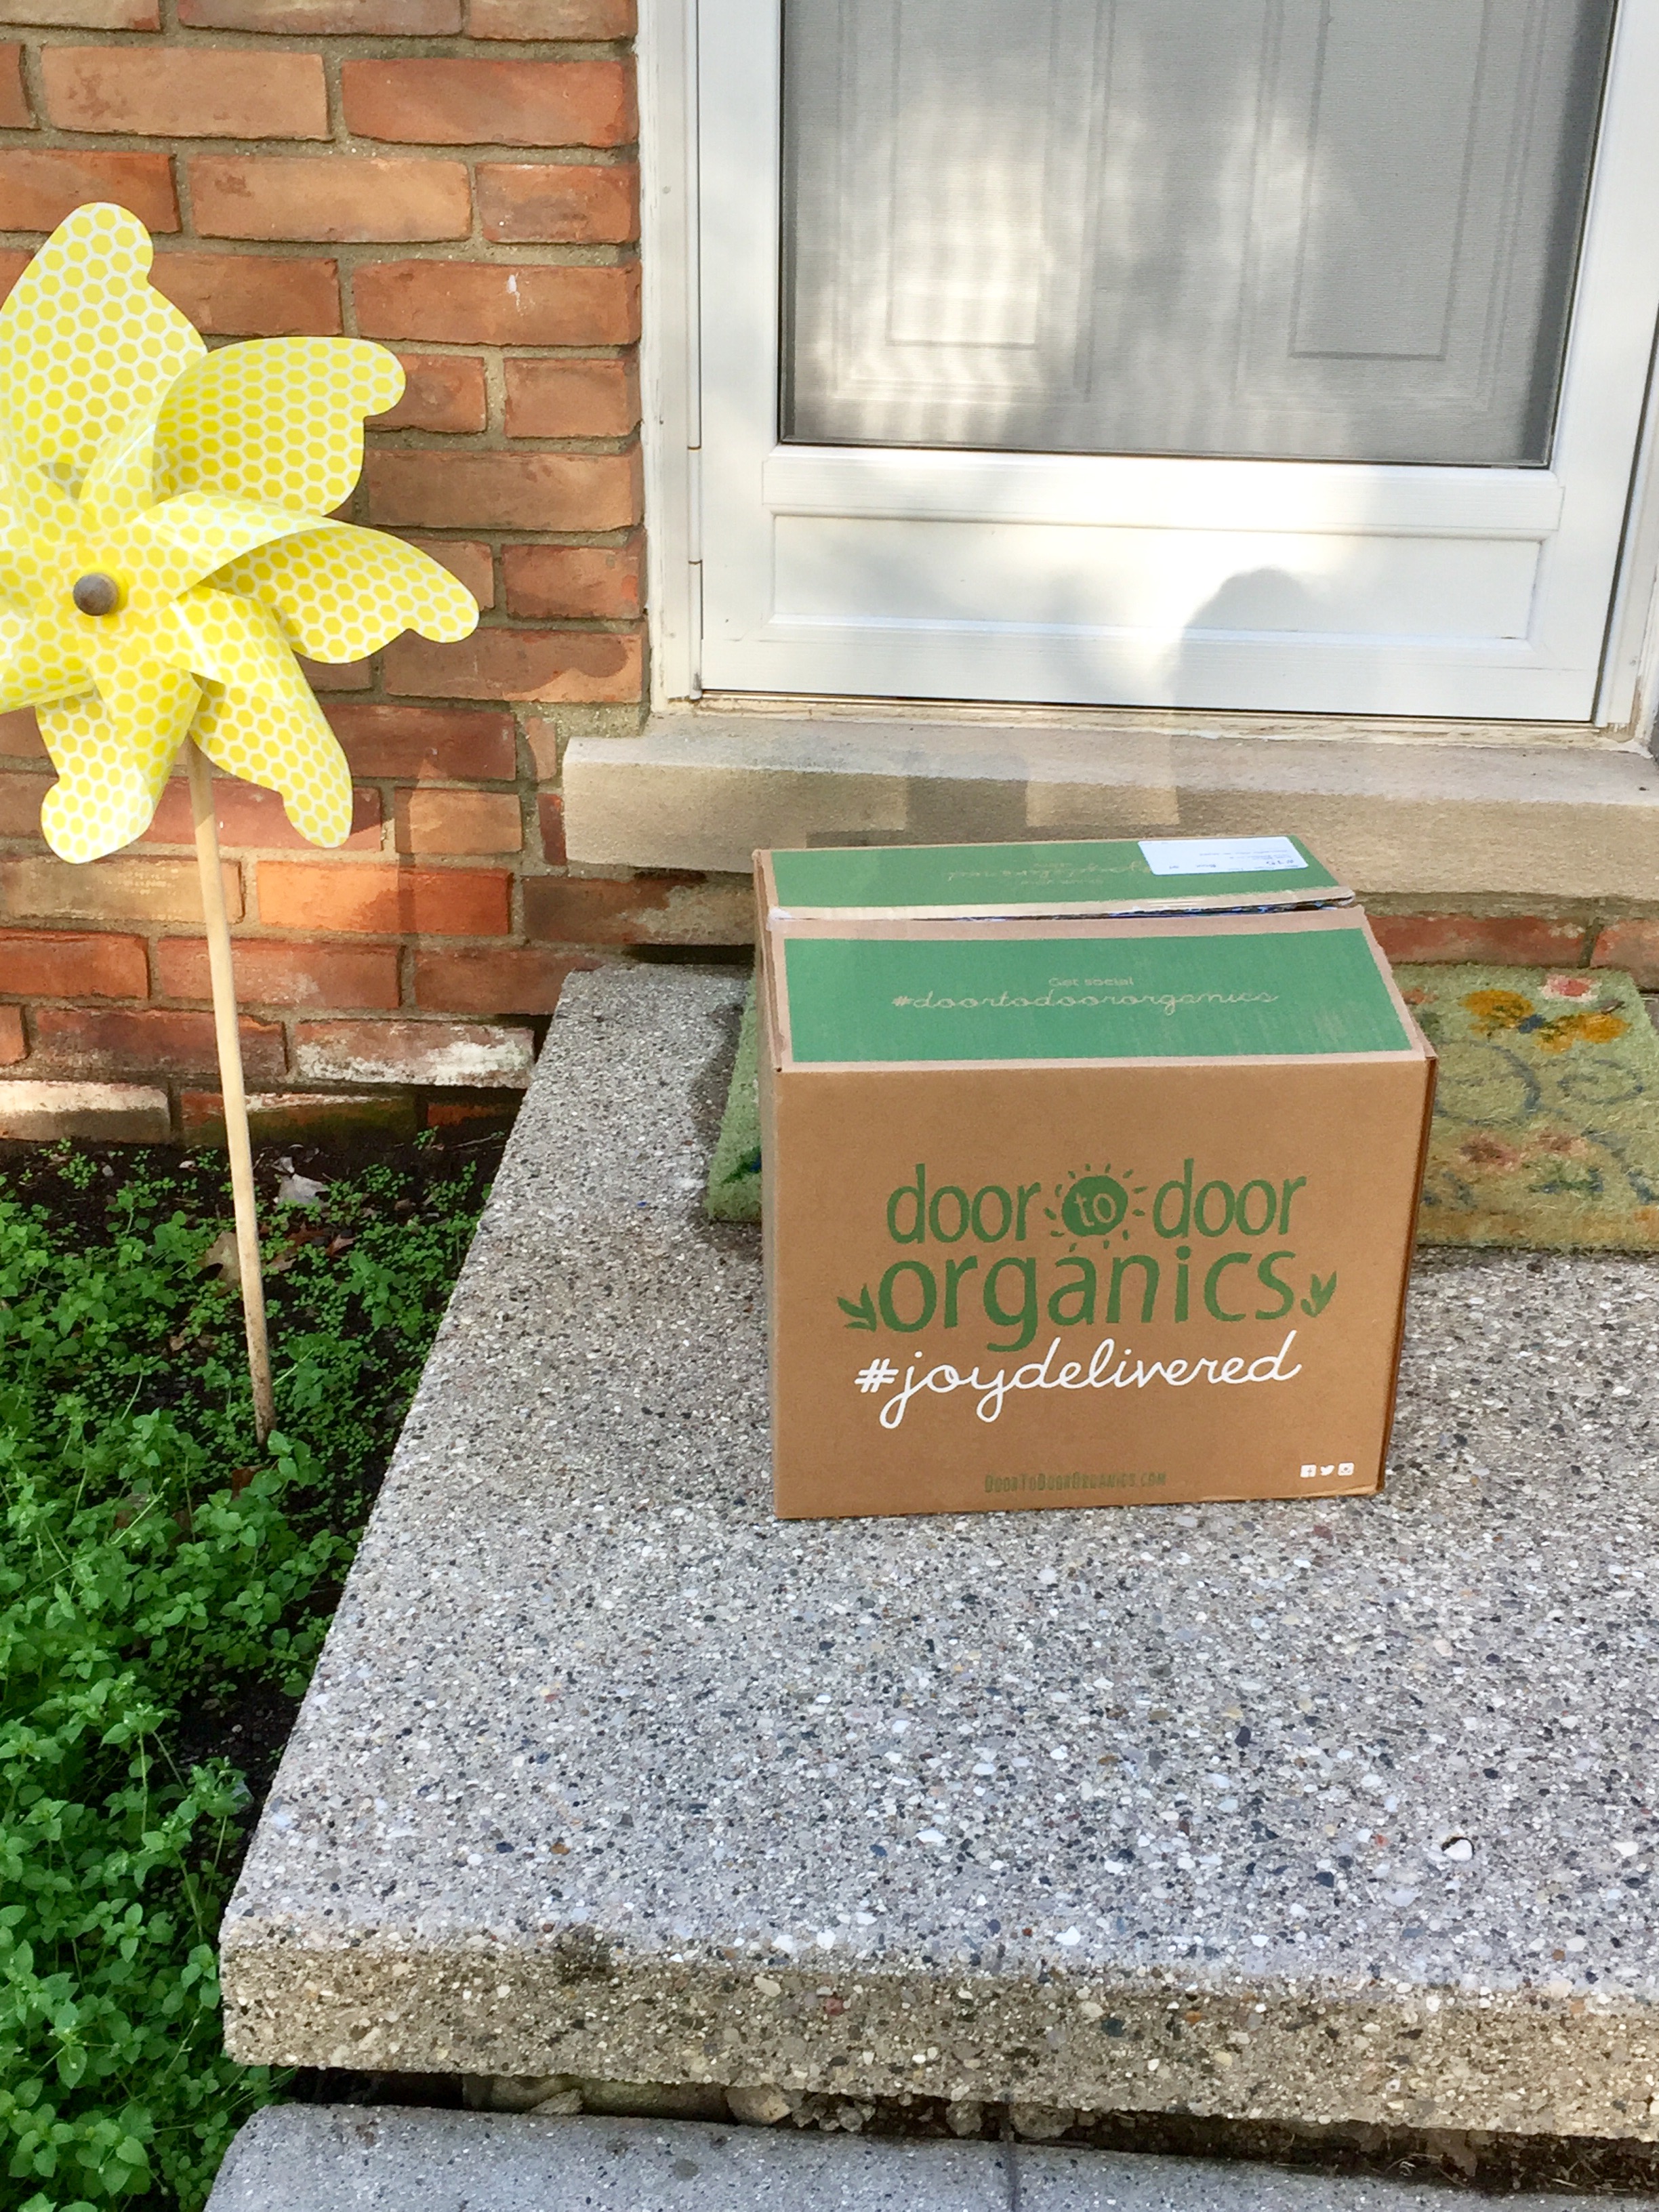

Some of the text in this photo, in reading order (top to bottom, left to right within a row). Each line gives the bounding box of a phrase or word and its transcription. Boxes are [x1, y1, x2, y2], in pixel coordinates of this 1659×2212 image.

[1048, 976, 1134, 987] Get social
[886, 1158, 1307, 1244] door to door
[878, 1246, 1296, 1352] organics
[854, 1329, 1303, 1430] #joydelivered
